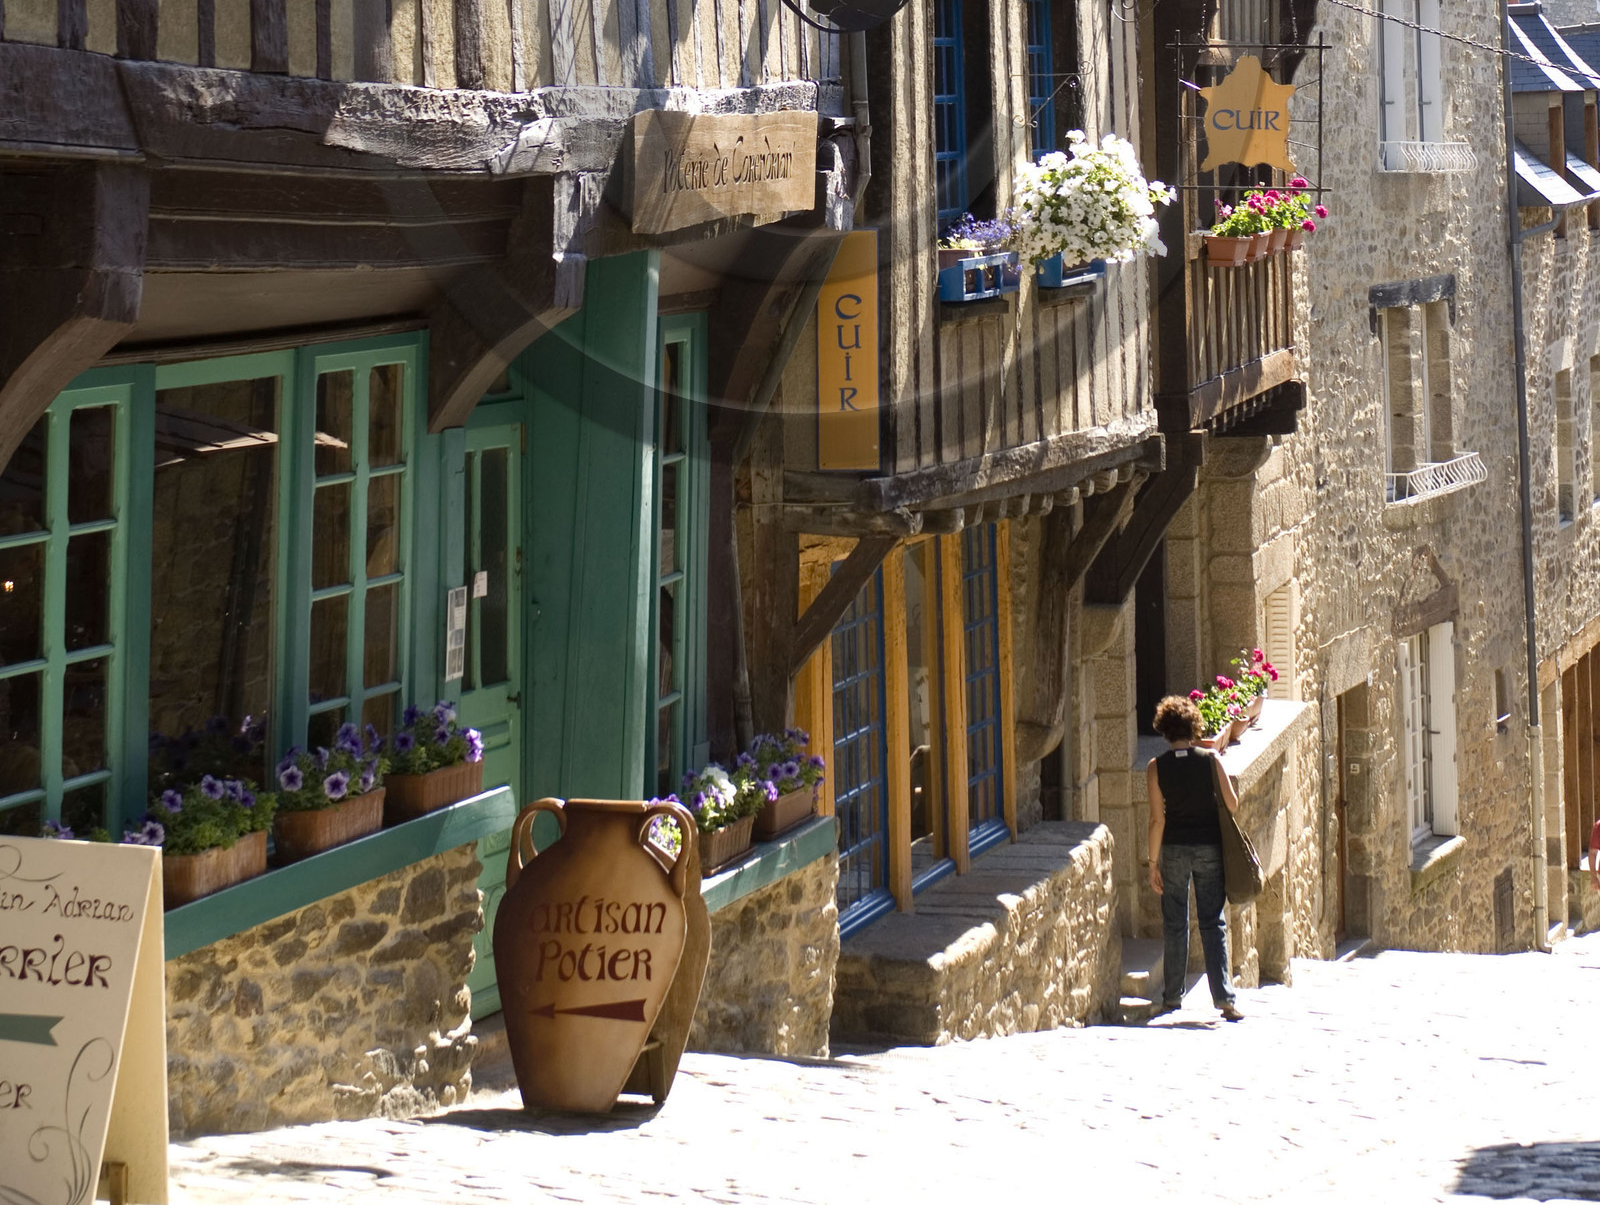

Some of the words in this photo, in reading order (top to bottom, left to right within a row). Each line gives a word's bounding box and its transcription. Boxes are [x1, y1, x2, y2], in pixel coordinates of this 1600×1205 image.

[1212, 107, 1282, 131] CUIR
[663, 147, 709, 194] Poterie
[713, 142, 729, 186] de
